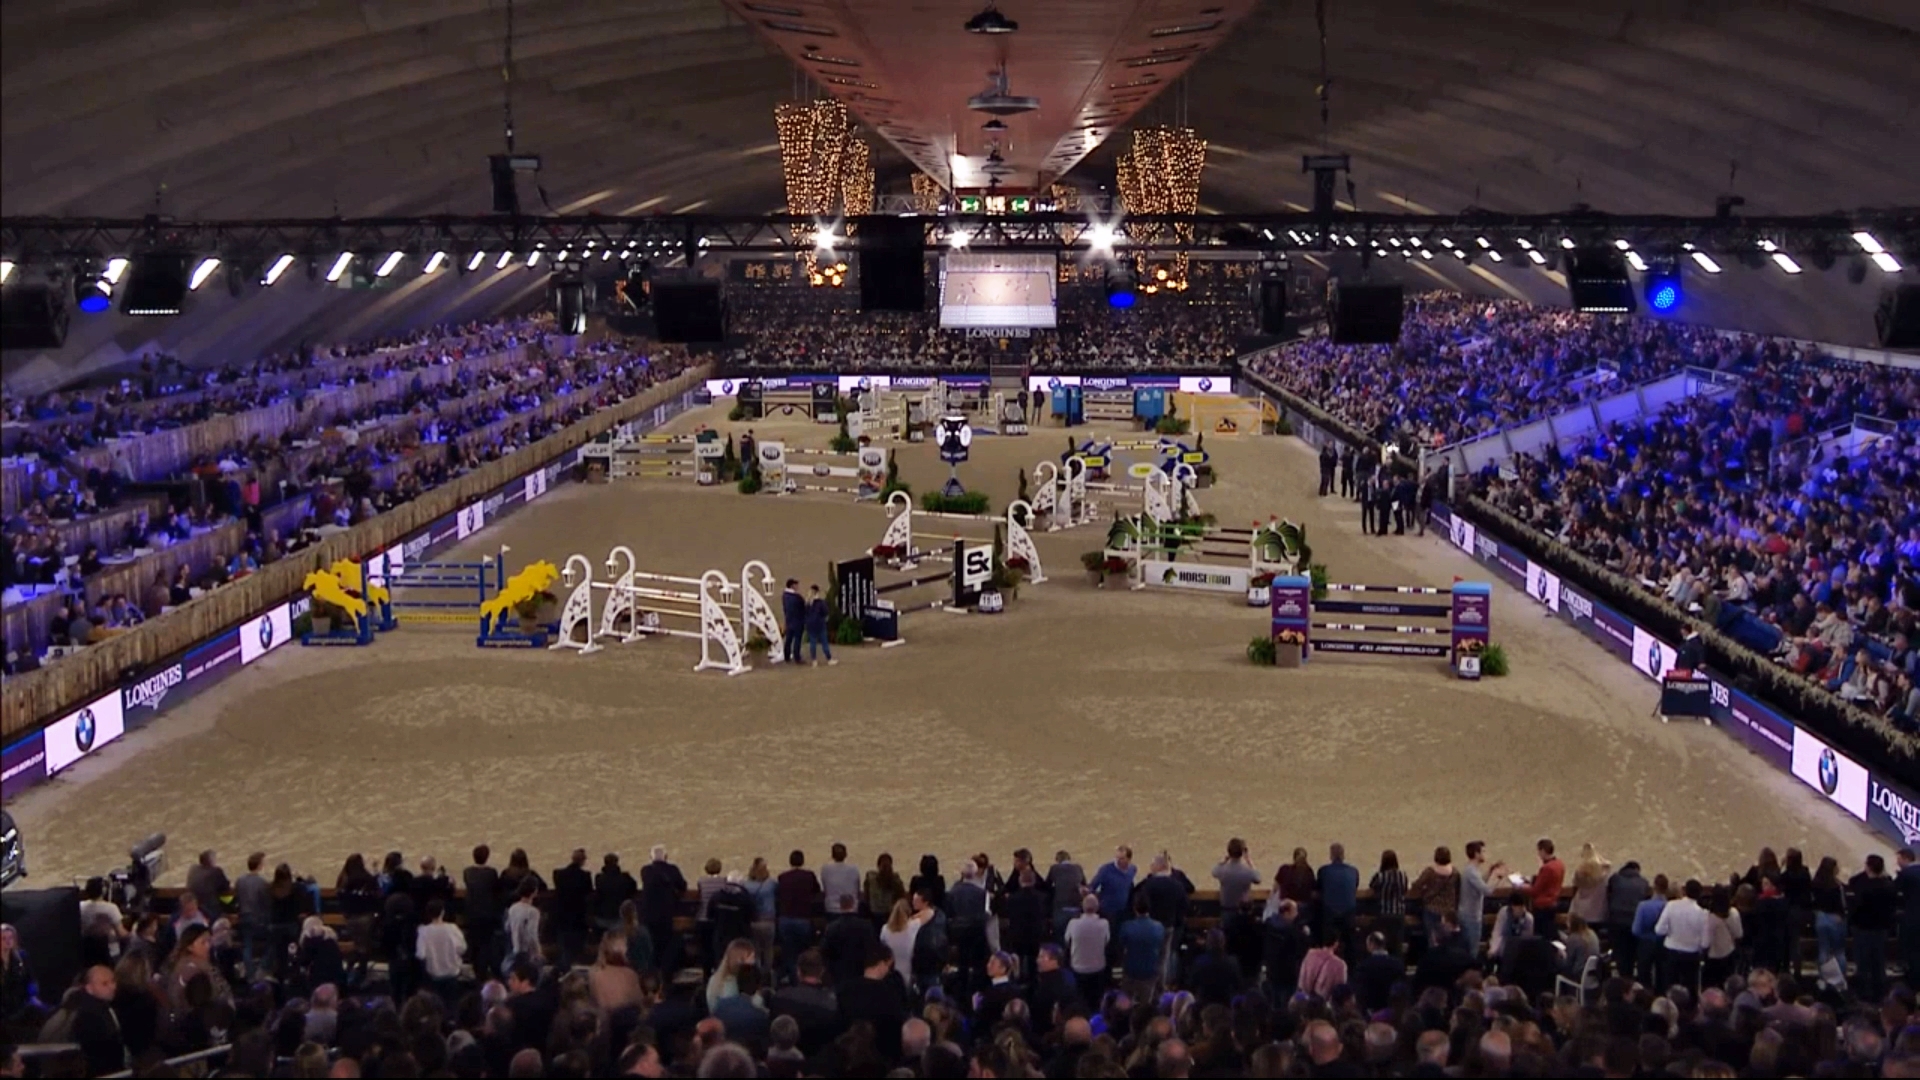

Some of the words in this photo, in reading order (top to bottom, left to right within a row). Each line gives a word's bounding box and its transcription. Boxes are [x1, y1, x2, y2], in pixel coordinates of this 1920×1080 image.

[965, 327, 1031, 339] LONGINES
[1466, 659, 1474, 670] 6
[125, 663, 182, 710] LONGINES
